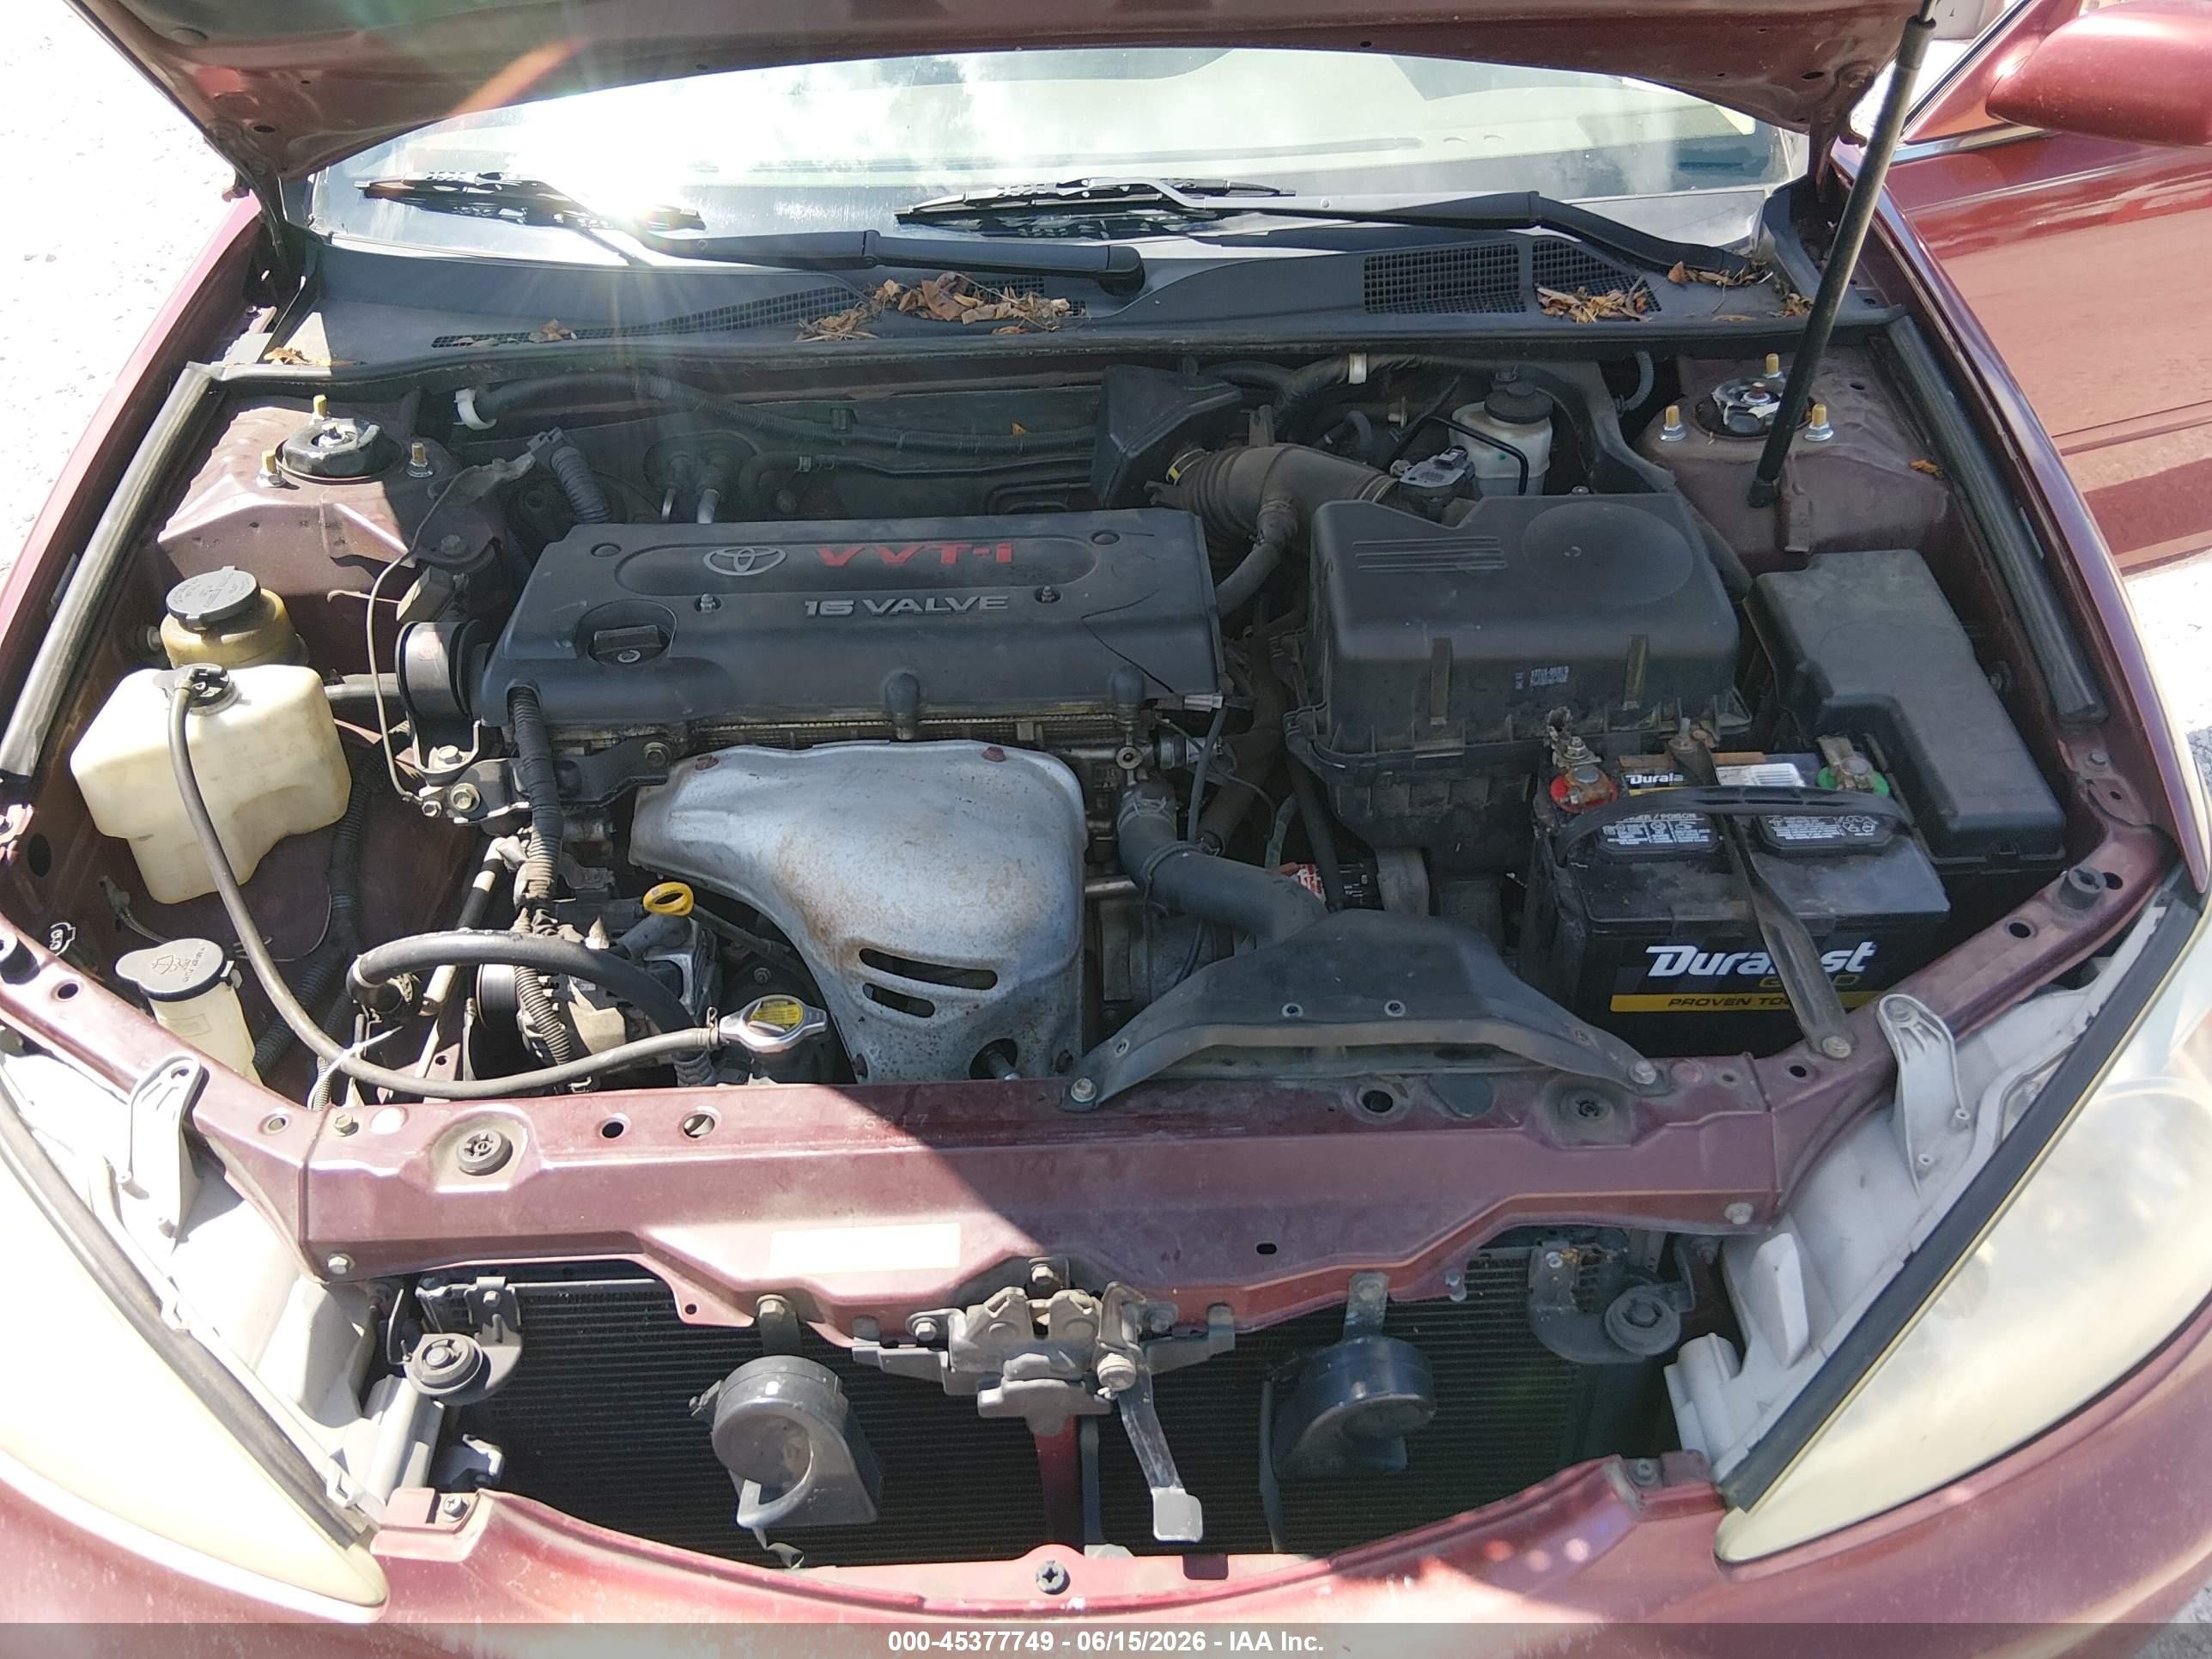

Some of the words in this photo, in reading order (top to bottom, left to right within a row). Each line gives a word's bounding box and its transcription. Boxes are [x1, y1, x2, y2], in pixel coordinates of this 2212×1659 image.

[805, 600, 855, 617] 16
[862, 596, 1009, 616] VALVE
[1626, 773, 1684, 785] Durala
[1645, 941, 1877, 976] Durast
[1668, 997, 1753, 1006] PROVEN
